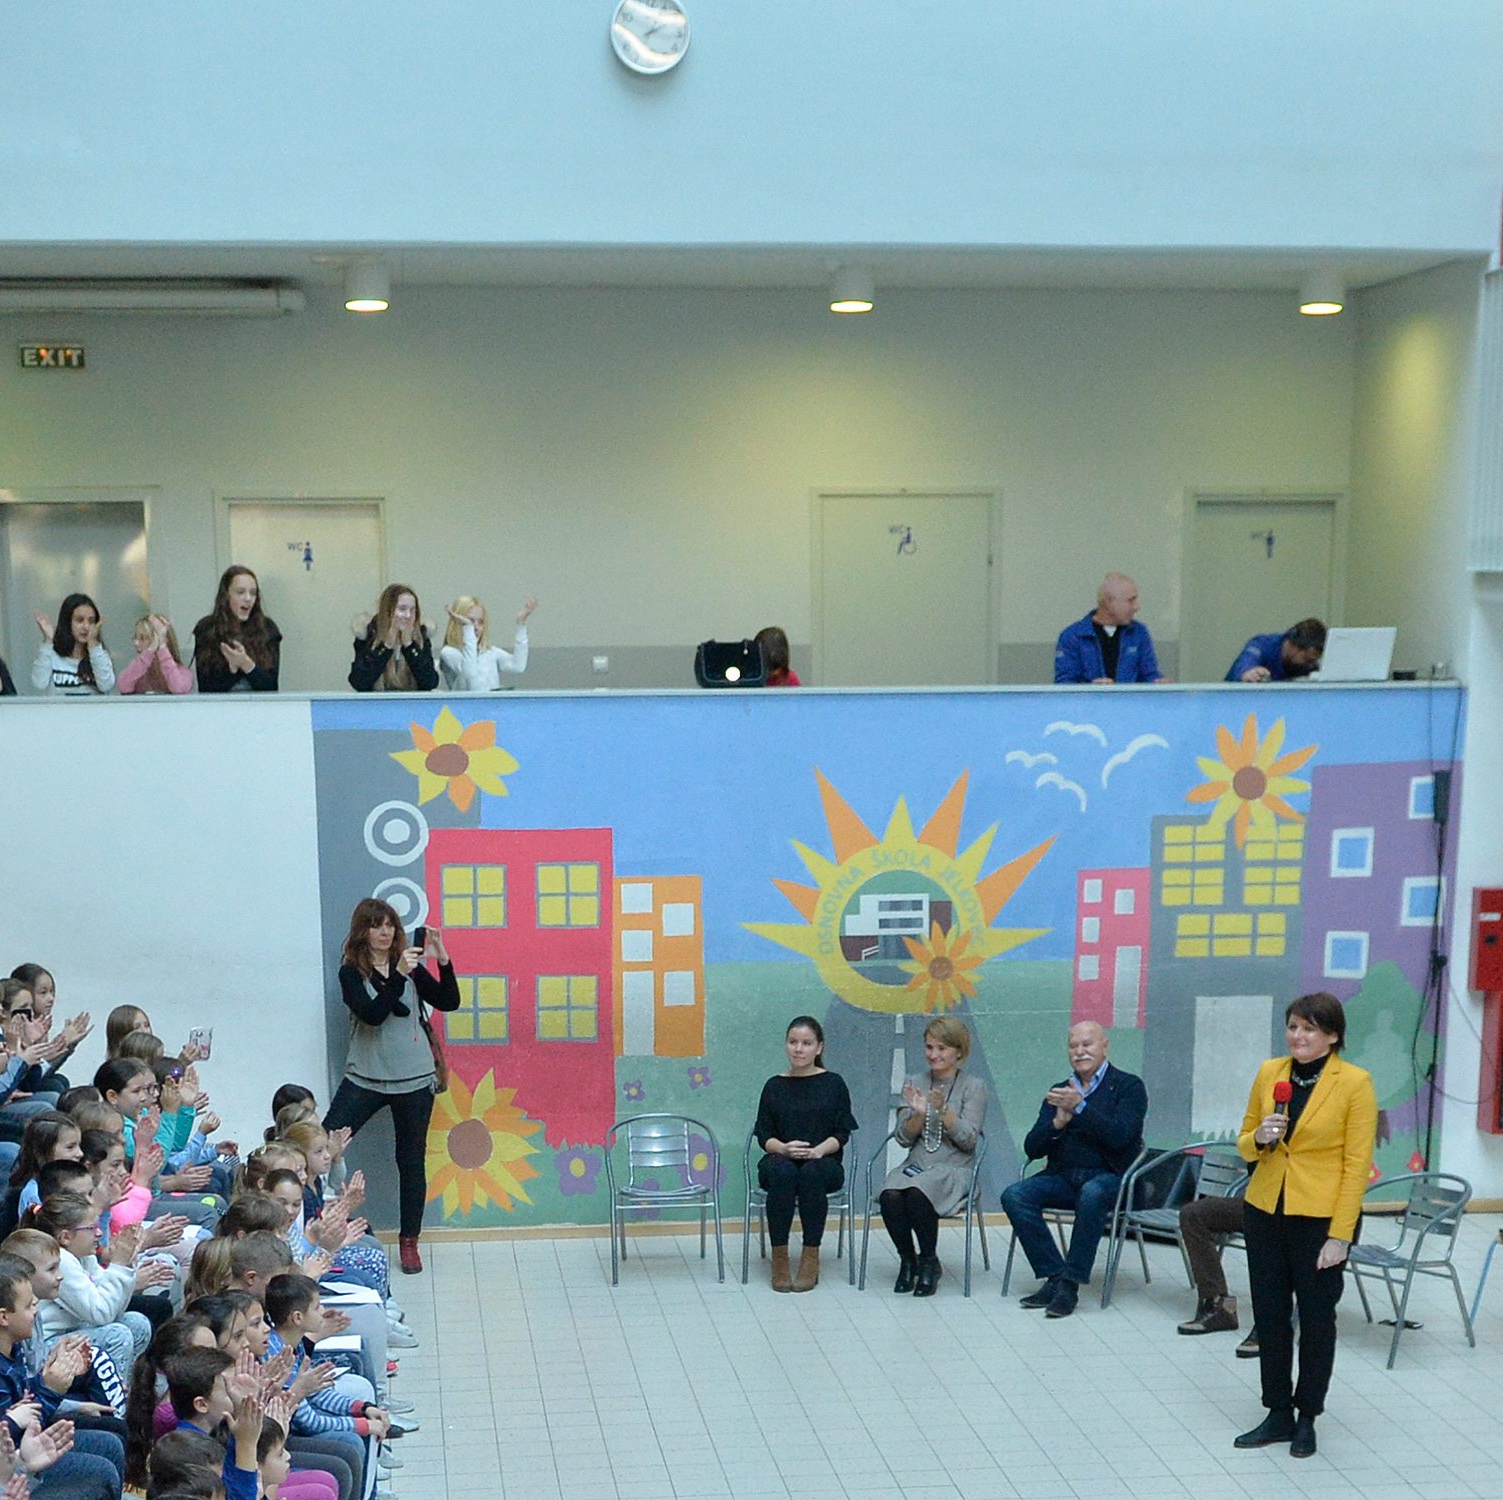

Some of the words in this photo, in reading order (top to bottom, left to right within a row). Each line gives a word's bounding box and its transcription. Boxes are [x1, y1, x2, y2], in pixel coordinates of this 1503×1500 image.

[23, 348, 83, 366] EXIT
[287, 541, 303, 552] WC
[817, 864, 865, 955] OSNOVNA
[870, 848, 931, 870] ŠKOLA
